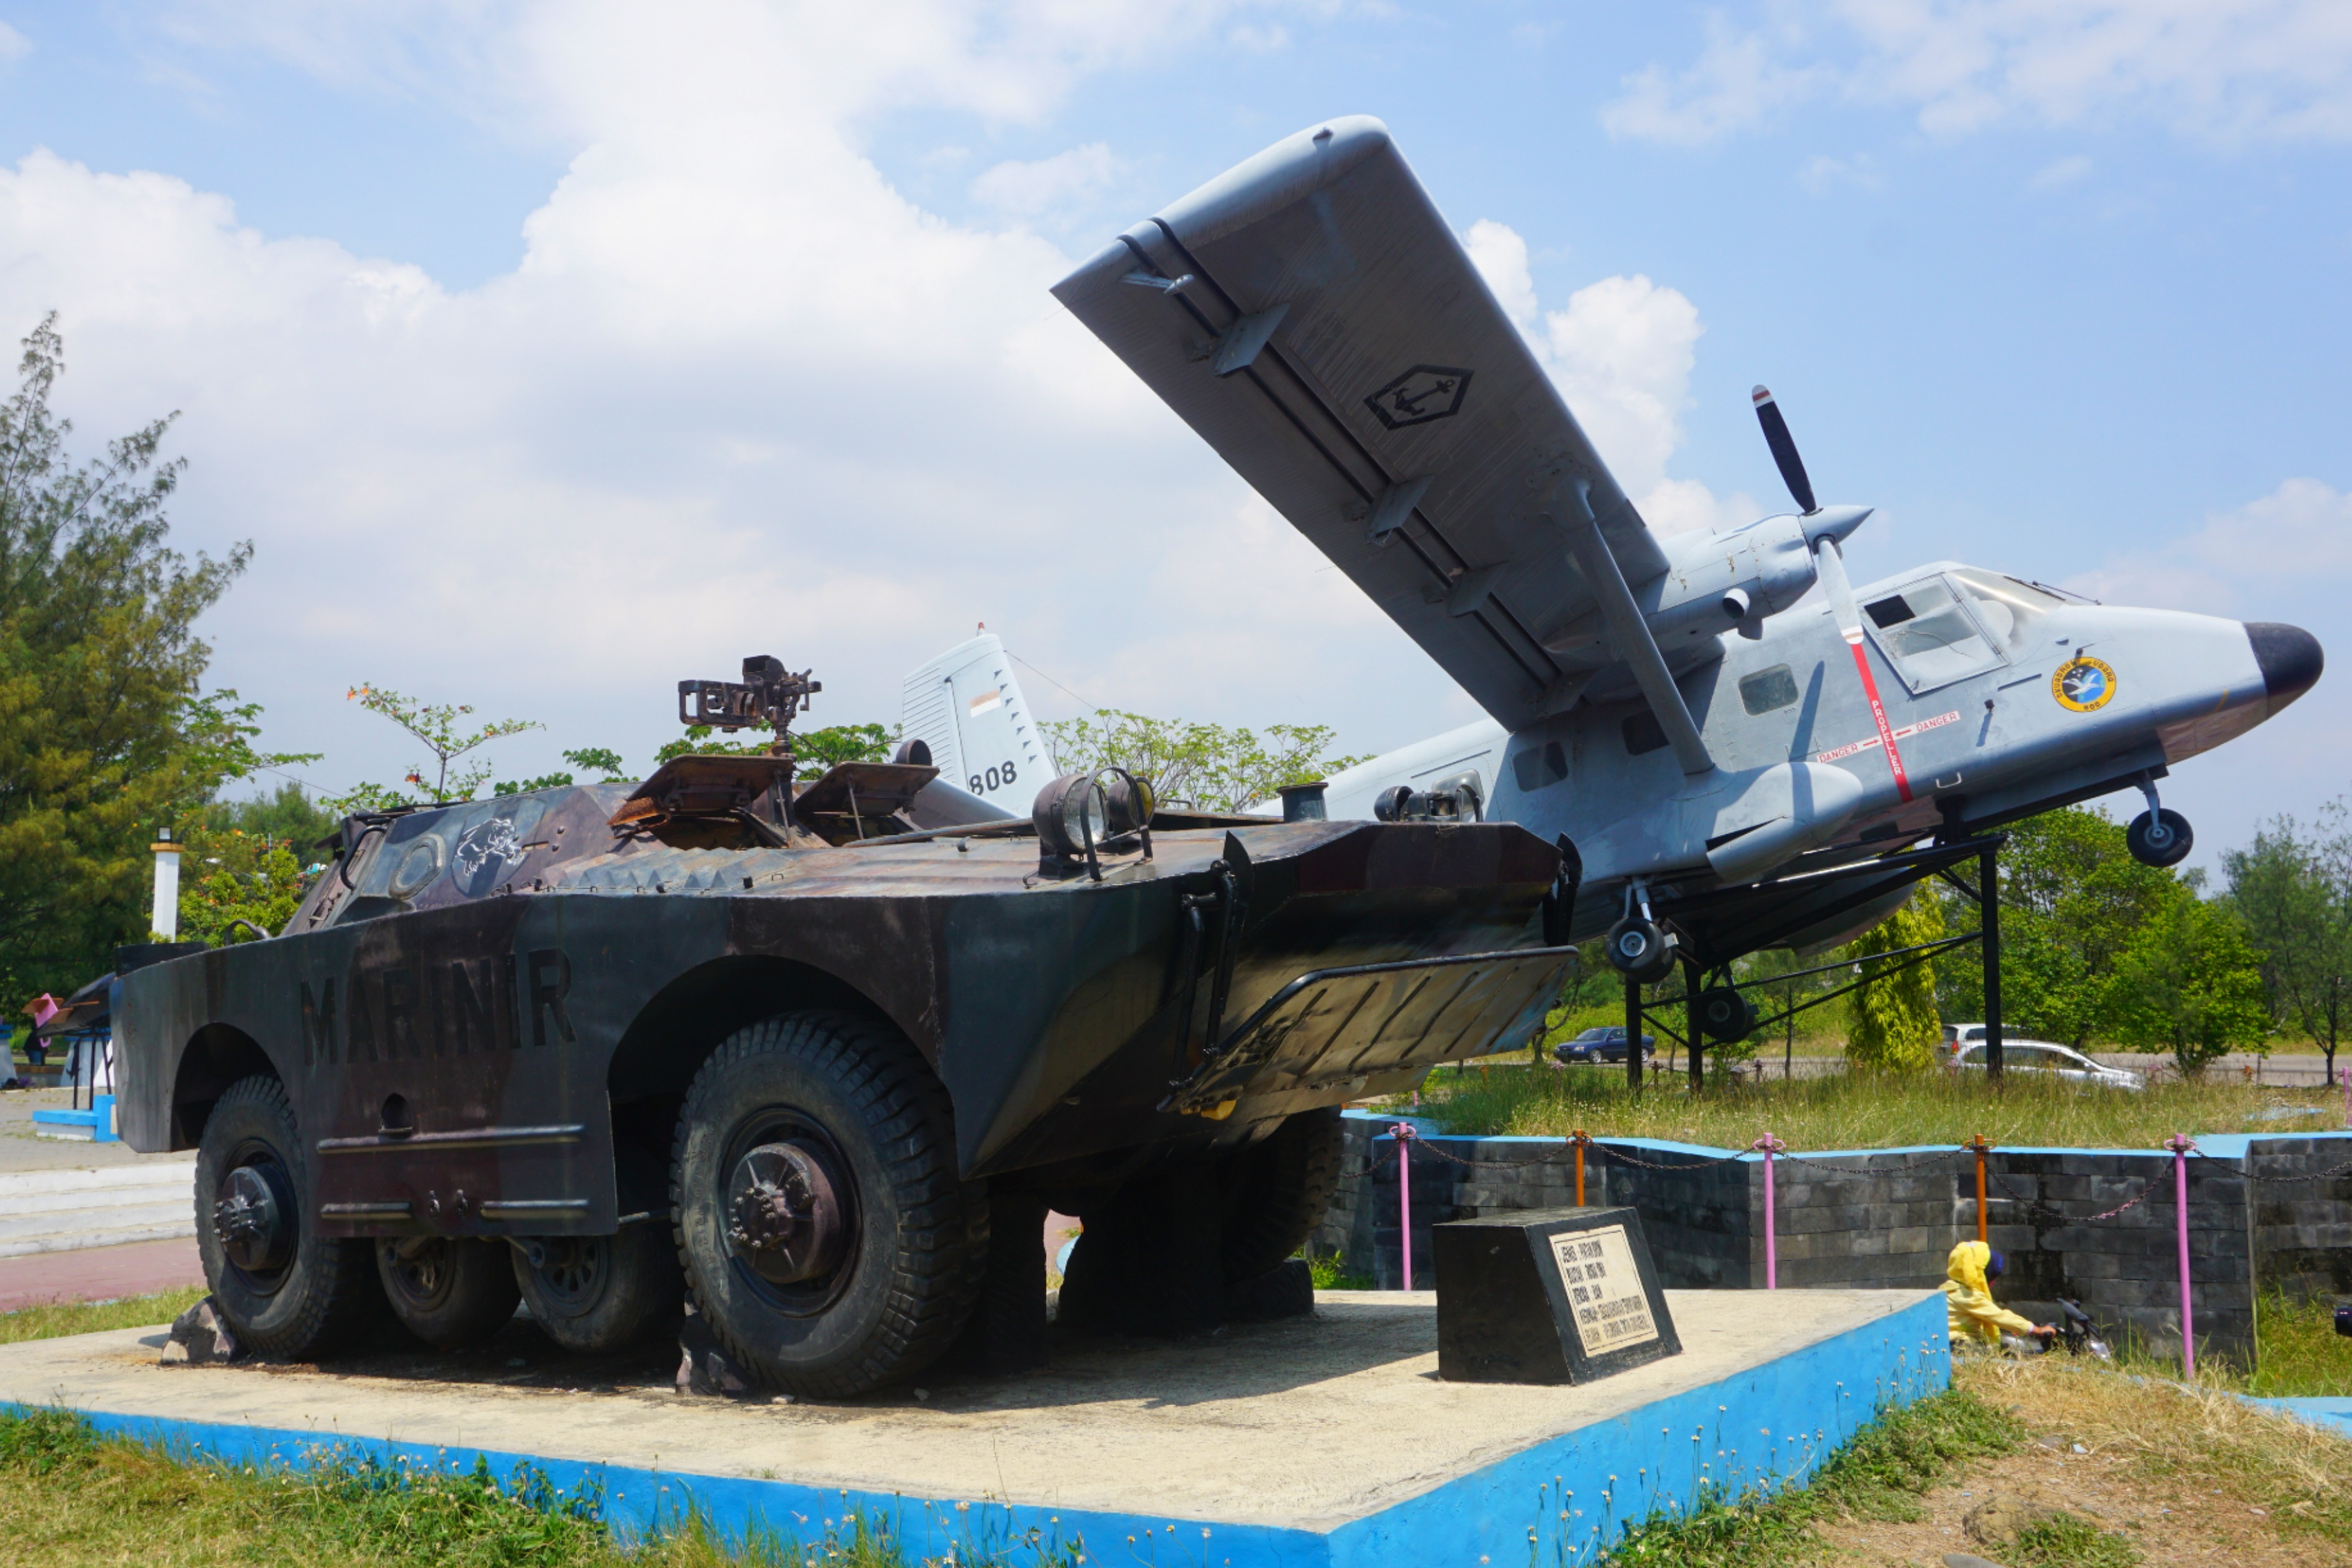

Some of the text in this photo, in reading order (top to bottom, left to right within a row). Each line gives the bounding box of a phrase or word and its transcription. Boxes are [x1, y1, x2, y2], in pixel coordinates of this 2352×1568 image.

[2054, 660, 2114, 698] SKUADRON UDARA
[1872, 700, 1902, 775] PROPELLER
[1916, 712, 1957, 732] DANGER
[1819, 743, 1858, 764] DANGER
[969, 760, 1017, 796] 808
[300, 947, 577, 1066] MARINIR
